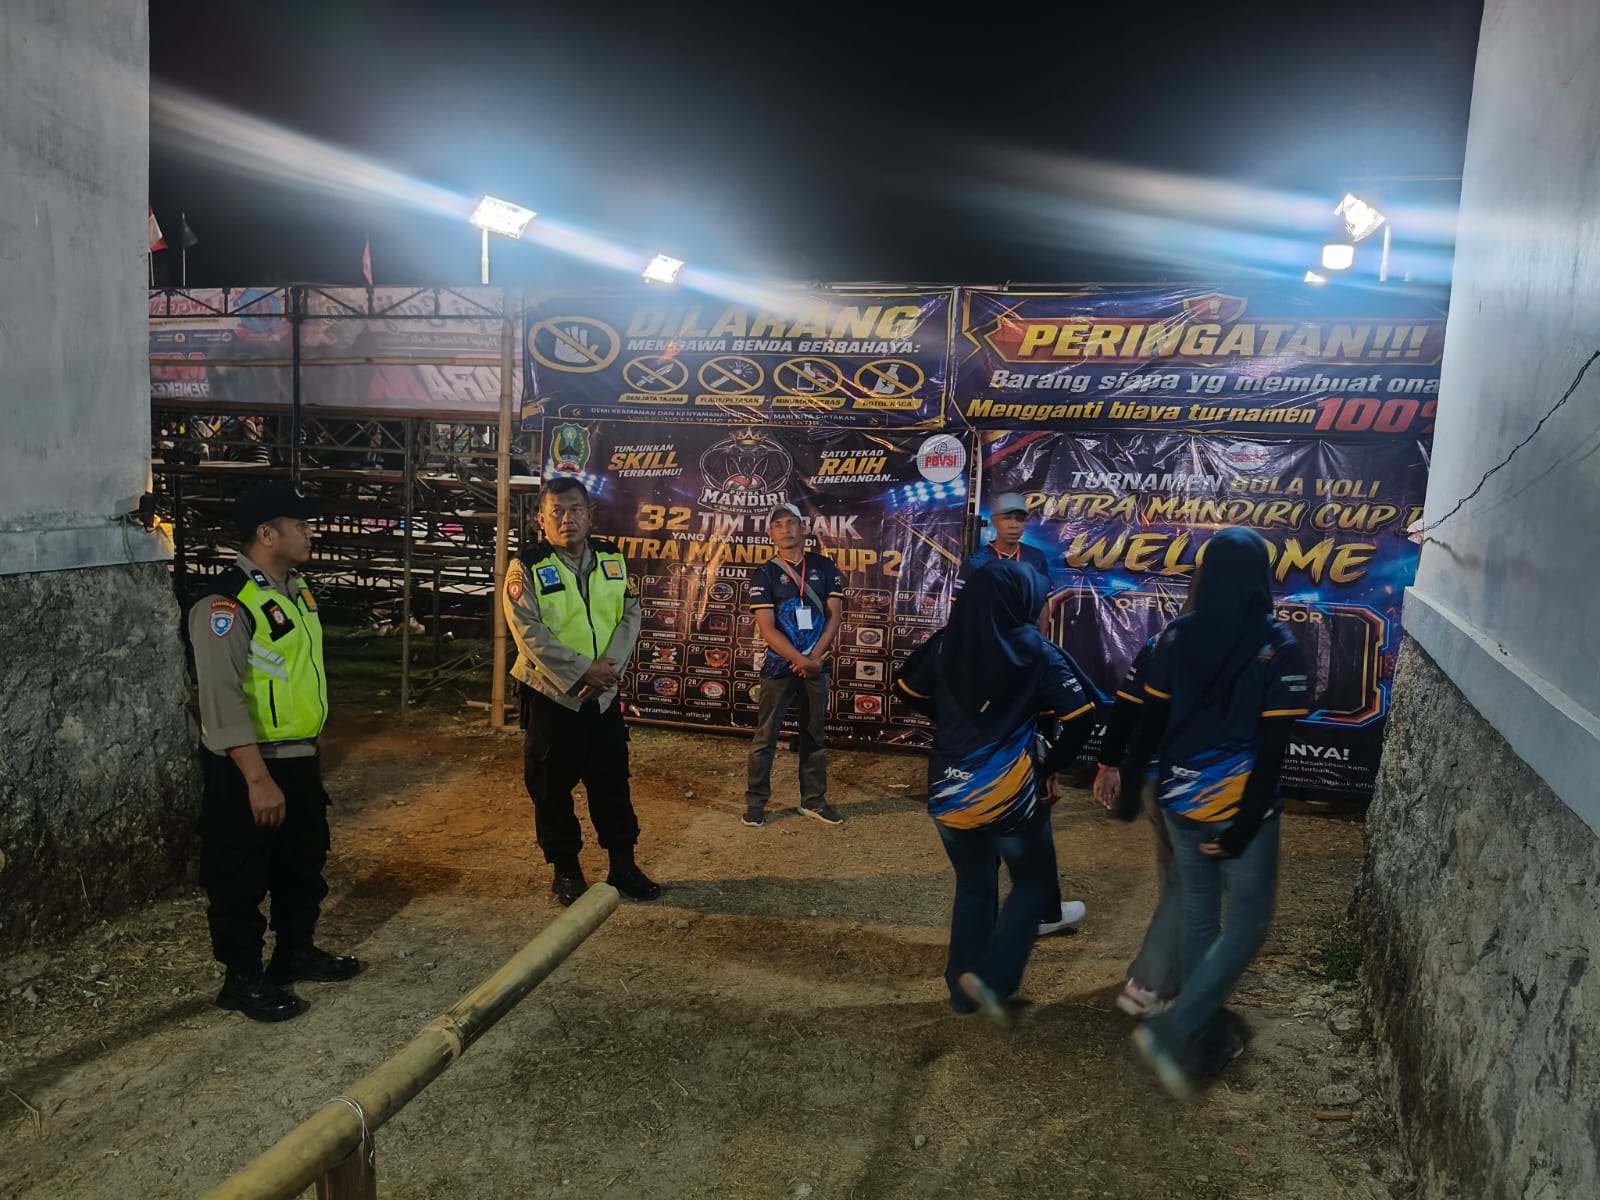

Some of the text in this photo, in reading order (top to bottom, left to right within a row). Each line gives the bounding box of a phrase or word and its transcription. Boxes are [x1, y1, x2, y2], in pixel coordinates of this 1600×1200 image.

[625, 305, 921, 339] DILARANG
[731, 339, 792, 352] BENDA
[798, 340, 921, 354] BERBAHAYA:
[1017, 323, 1429, 358] PERINGATAN!!!
[988, 370, 1091, 393] Barang
[1098, 372, 1179, 392] siapa
[1186, 374, 1227, 394] yg
[1234, 373, 1383, 393] membuat
[966, 398, 1104, 421] Mengganti
[1108, 401, 1182, 422] biaya
[1187, 403, 1316, 424] turnamen
[613, 443, 674, 453] TUNJUKKAN
[820, 449, 884, 459] SATU TEKAD
[607, 451, 678, 471] SKILL
[818, 457, 888, 476] RAIH
[924, 454, 957, 468] PBVSI
[618, 467, 683, 478] TERBAIKMU!
[809, 474, 900, 486] KEMENANGAN...
[701, 488, 786, 507] MANDIRI
[1314, 478, 1381, 499] VOLI
[638, 504, 692, 531] 32
[698, 511, 744, 533] TIM
[1025, 491, 1138, 523] PUTRA
[1147, 496, 1306, 528] MANDIRI
[1314, 503, 1397, 531] CUP
[672, 531, 705, 542] YANG
[804, 538, 817, 547] DI
